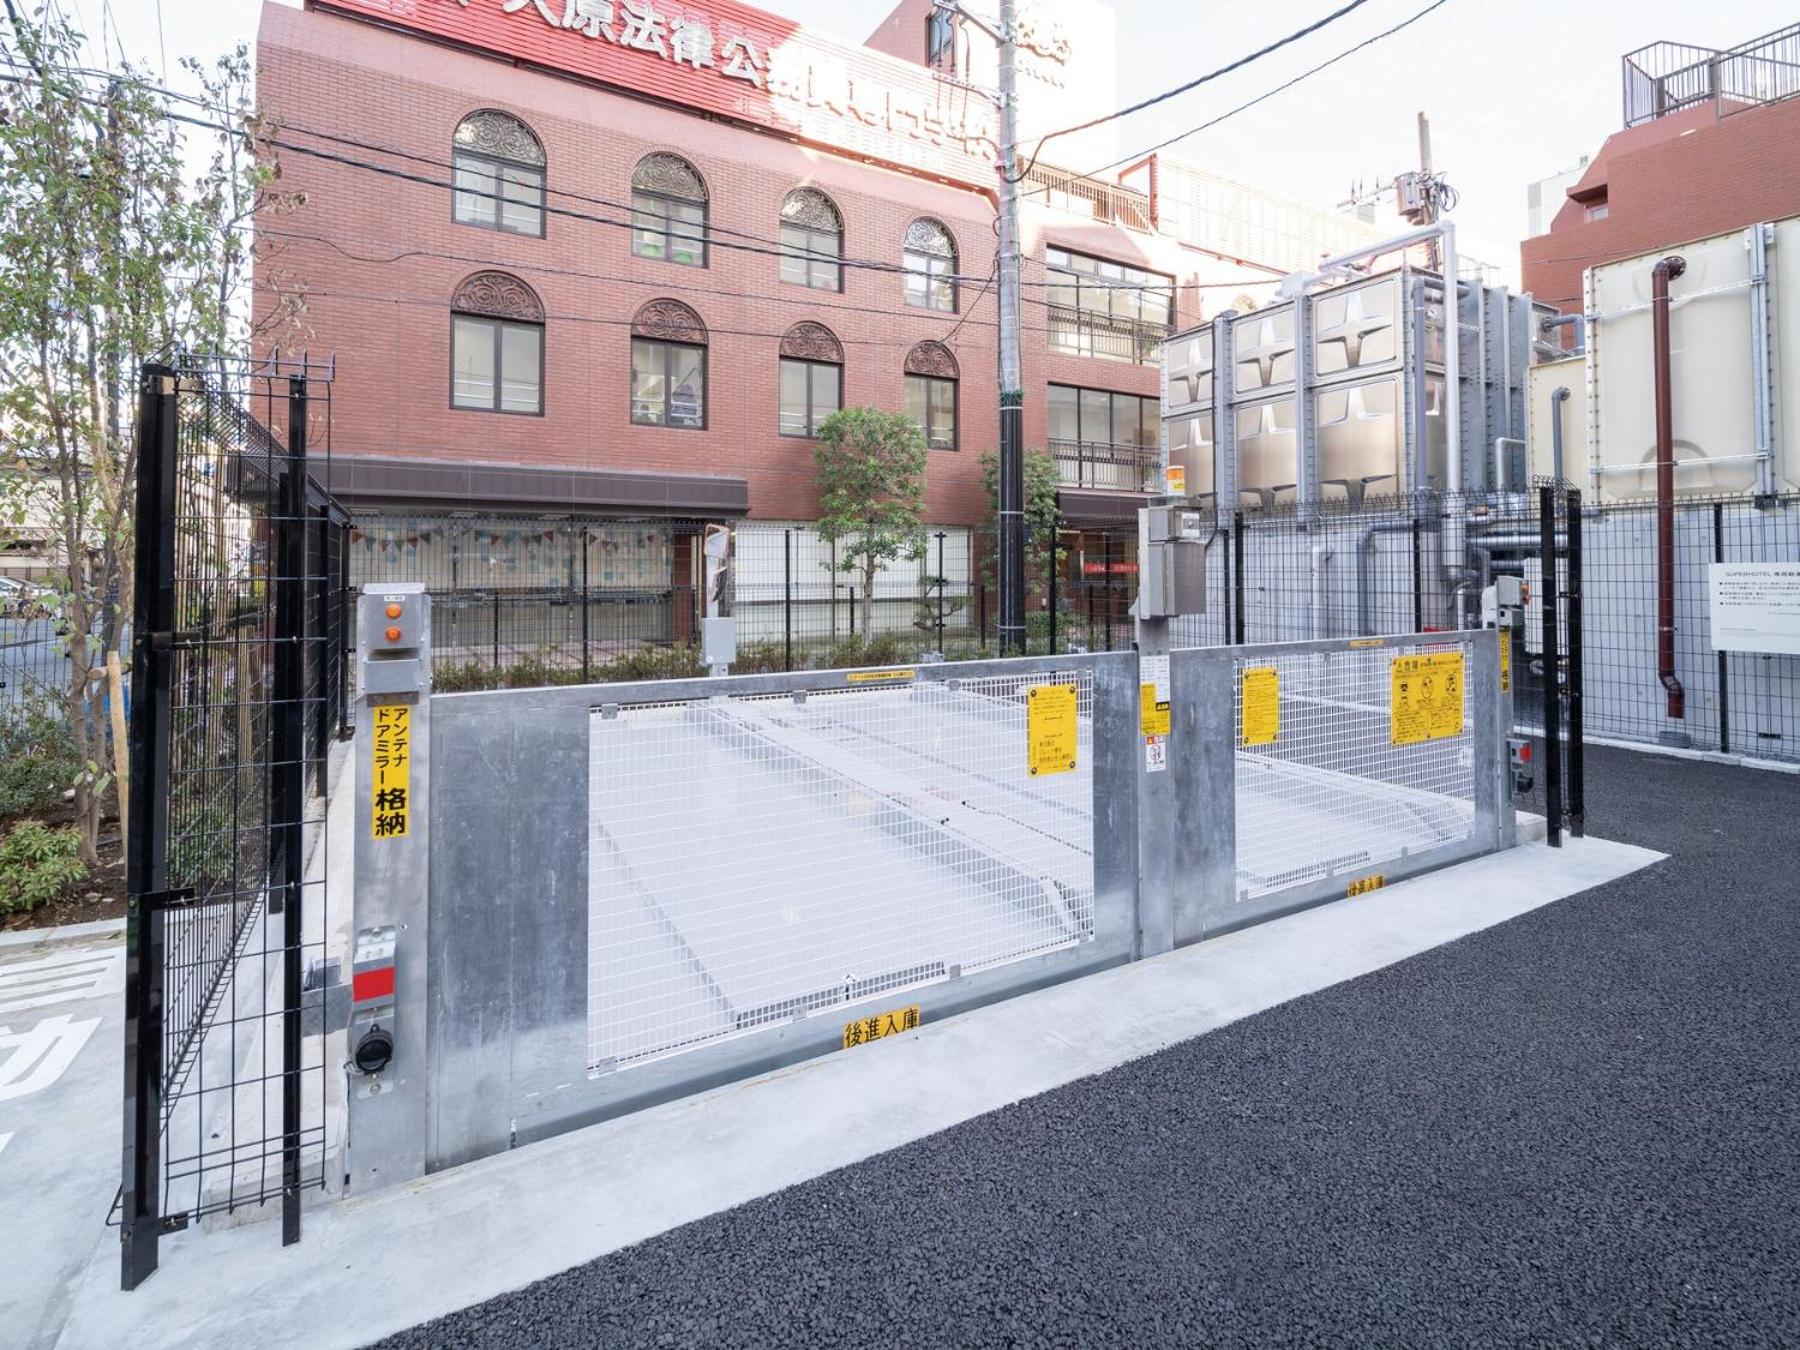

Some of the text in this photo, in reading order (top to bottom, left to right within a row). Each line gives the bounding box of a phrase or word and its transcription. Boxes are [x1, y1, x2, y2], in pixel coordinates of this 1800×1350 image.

[375, 708, 391, 785] ドアミラー
[392, 708, 408, 768] アンテナ
[375, 788, 407, 837] 格納
[845, 1007, 918, 1048] 後進入庫
